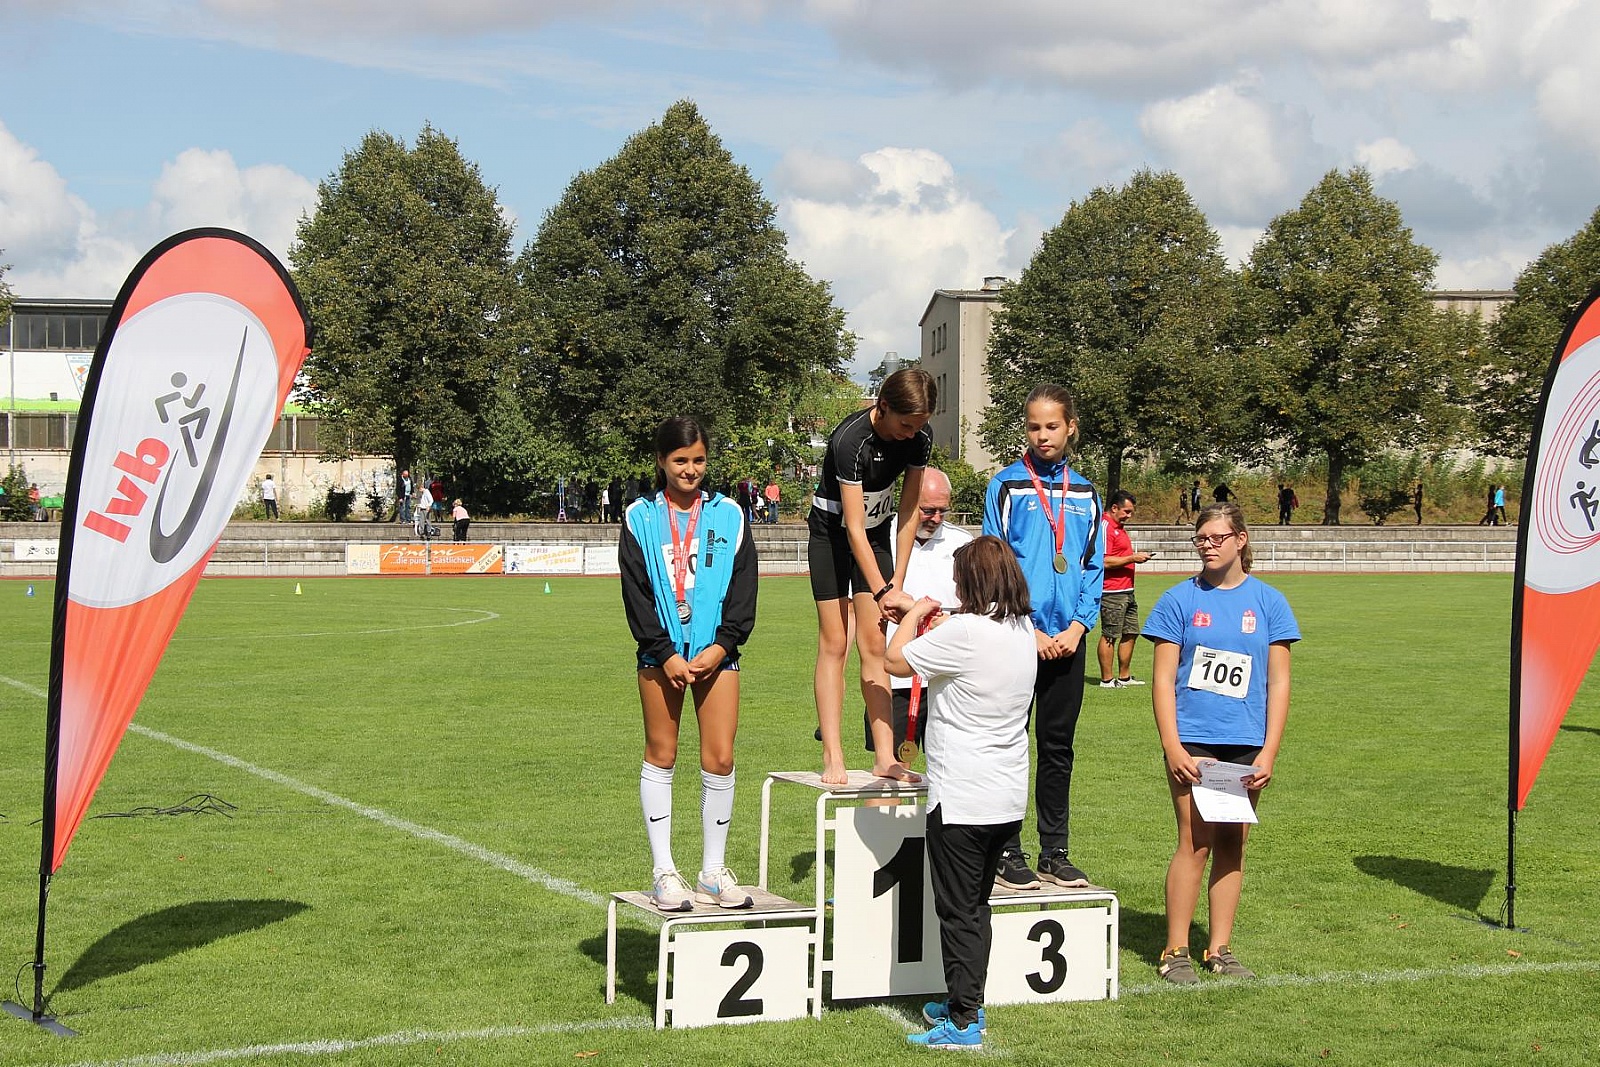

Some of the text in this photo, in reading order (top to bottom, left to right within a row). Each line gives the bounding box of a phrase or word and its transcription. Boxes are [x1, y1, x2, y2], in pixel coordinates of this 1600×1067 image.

[83, 438, 169, 543] lvb
[864, 496, 890, 518] 40
[45, 547, 56, 555] SG
[1202, 660, 1244, 687] 106
[873, 836, 925, 963] 1
[716, 941, 764, 1018] 2
[1025, 919, 1068, 994] 3
